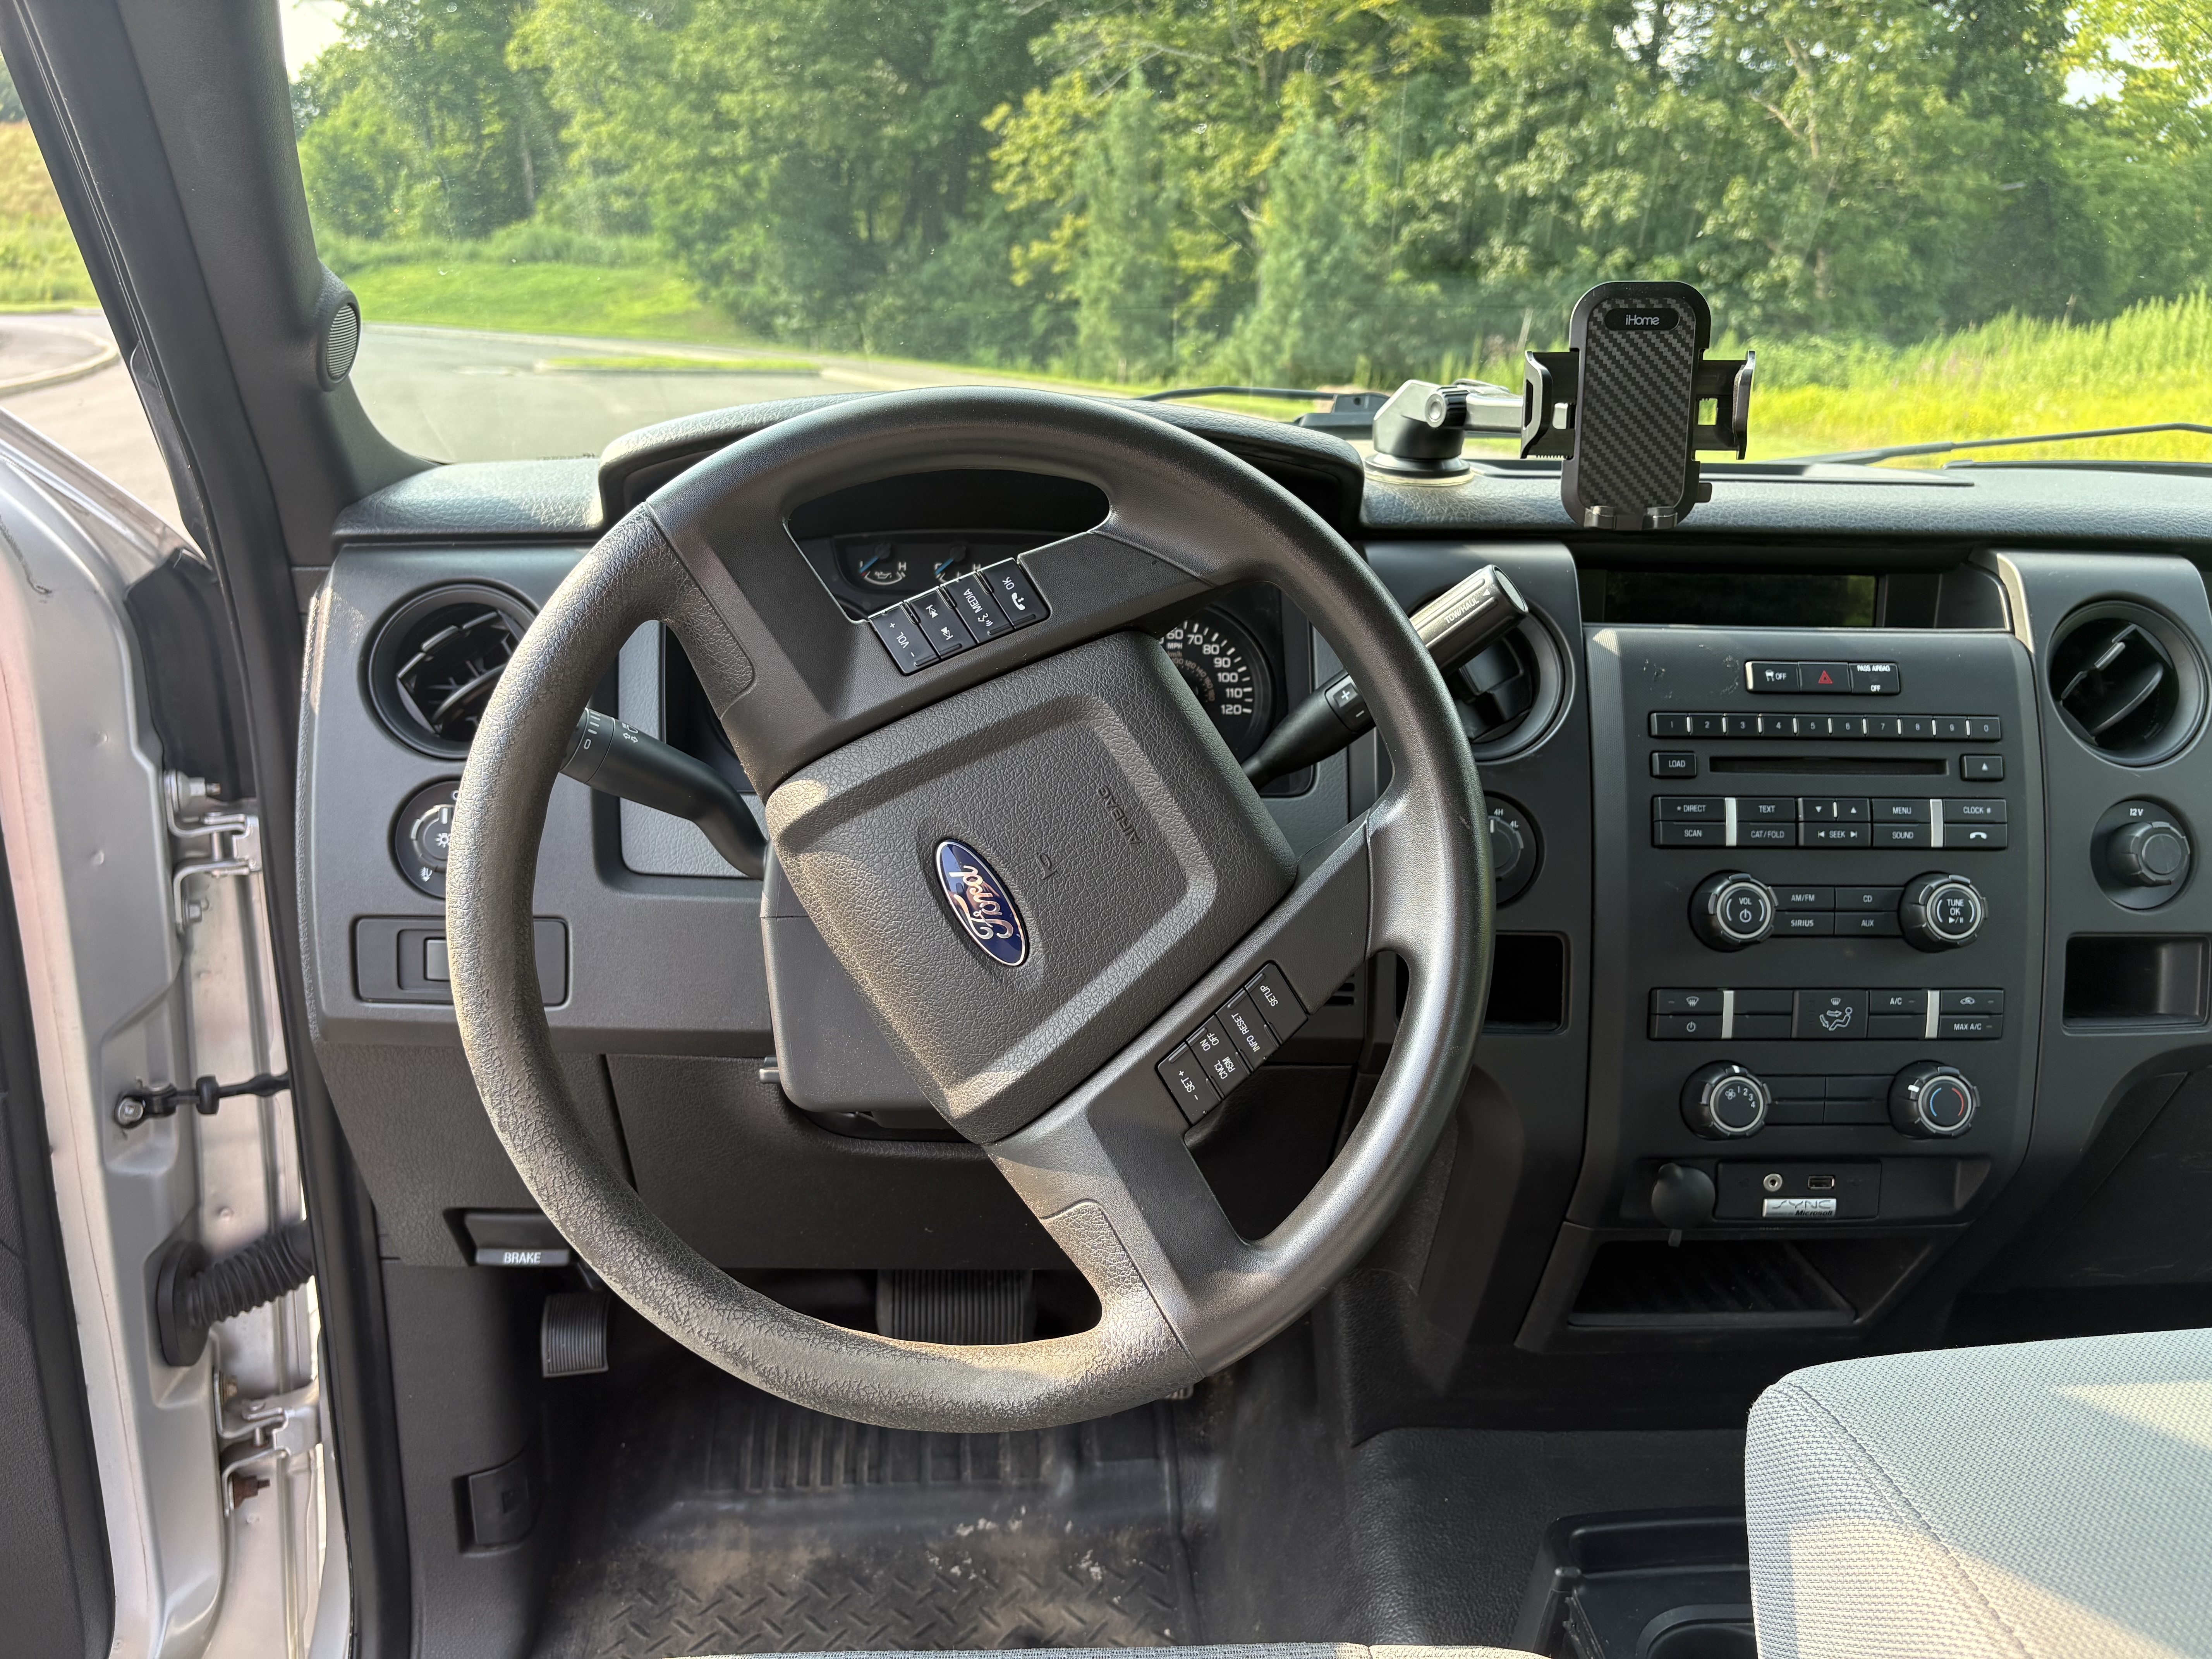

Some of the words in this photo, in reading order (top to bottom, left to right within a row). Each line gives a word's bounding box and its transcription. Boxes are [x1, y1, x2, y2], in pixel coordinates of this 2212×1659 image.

[1626, 314, 1659, 325] iHome
[1002, 577, 1015, 590] OK
[963, 588, 983, 613] MEDIA
[1444, 598, 1479, 623] TOW/HAUL
[896, 632, 909, 648] VOL
[1187, 634, 1203, 645] 70
[1202, 644, 1219, 655] 80
[1185, 659, 1196, 669] 120
[1213, 657, 1231, 668] 90
[1218, 672, 1238, 683] 100
[1226, 688, 1243, 698] 110
[1221, 704, 1242, 715] 120
[1097, 784, 1142, 845] AIRBAG
[1963, 806, 1984, 814] CLOCK
[1510, 820, 1519, 828] 4L
[1751, 830, 1784, 838] CAT/FOLD
[1892, 831, 1913, 839] SOUND
[950, 865, 1014, 939] Ford
[1791, 894, 1815, 902] AM/FM
[1946, 898, 1964, 907] TUNE
[1950, 907, 1961, 916] OK
[1790, 919, 1814, 927] SIRIUS
[1260, 985, 1278, 1006] SETUP
[1890, 997, 1903, 1005] A/C
[1231, 1013, 1250, 1035] RESET
[1207, 1032, 1219, 1046] OFF
[1247, 1036, 1261, 1052] INFO
[1200, 1039, 1211, 1051] ON
[1214, 1060, 1228, 1079] CNCL
[1222, 1056, 1236, 1072] RSM
[1181, 1077, 1195, 1092] SET
[1743, 1088, 1748, 1096] 2
[1748, 1093, 1753, 1101] 3
[1772, 1199, 1831, 1209] SYNC
[504, 1252, 541, 1264] BRAKE
